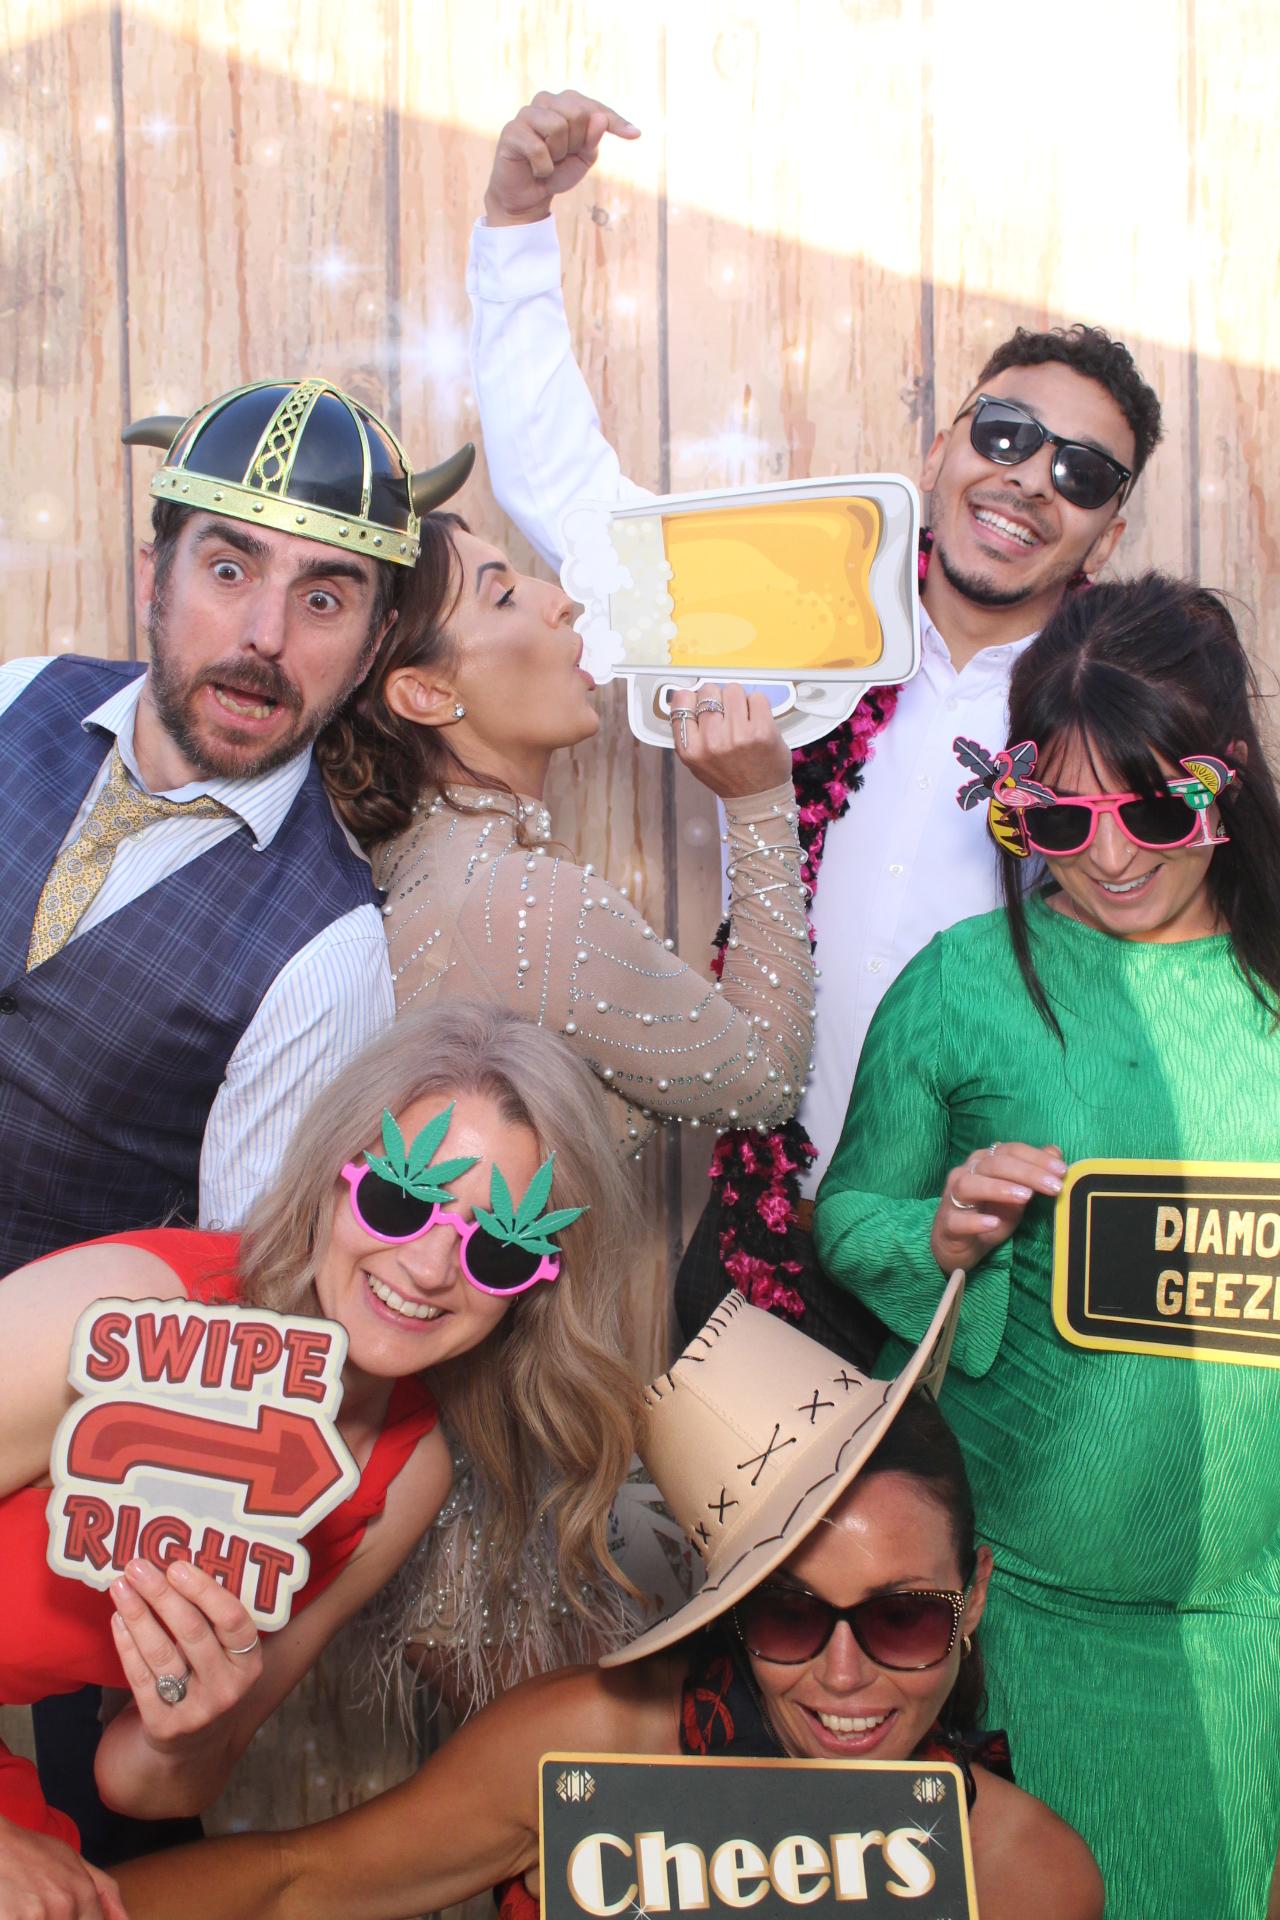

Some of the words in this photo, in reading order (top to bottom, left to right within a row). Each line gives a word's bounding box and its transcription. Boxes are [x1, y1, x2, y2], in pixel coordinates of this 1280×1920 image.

[86, 1312, 331, 1402] SWIPE
[63, 1495, 294, 1614] RIGHT
[567, 1827, 936, 1916] Cheers
